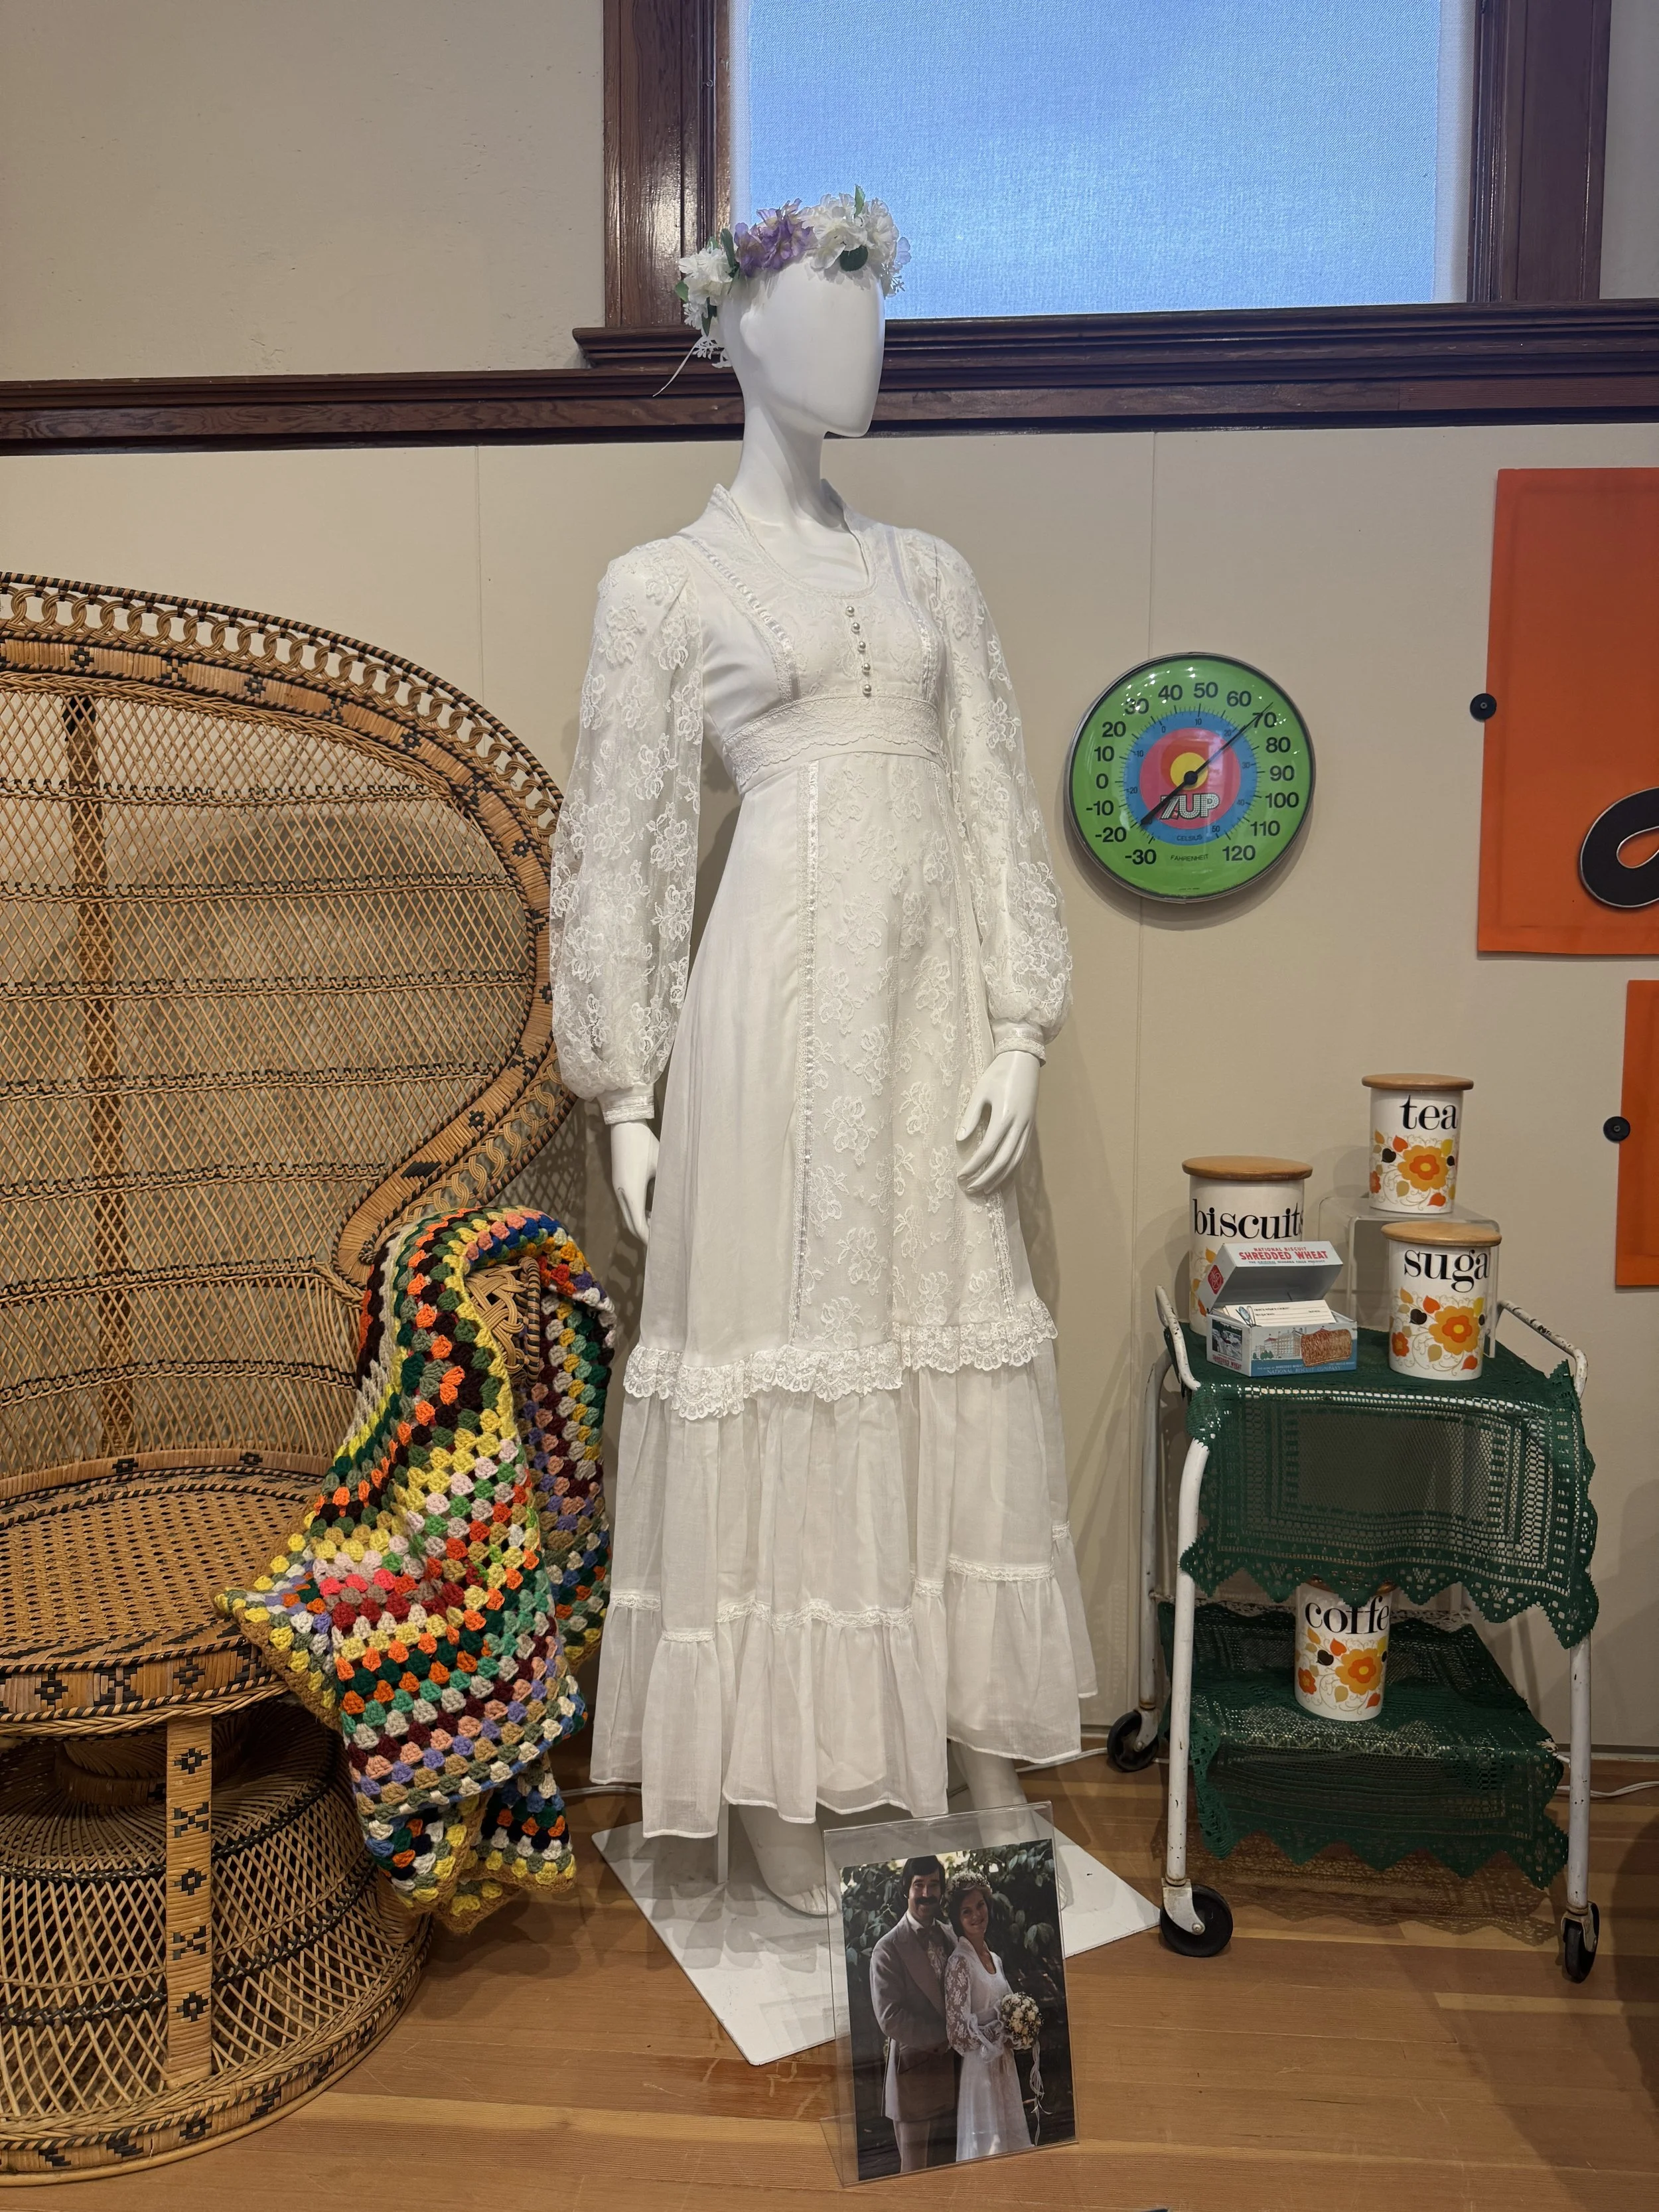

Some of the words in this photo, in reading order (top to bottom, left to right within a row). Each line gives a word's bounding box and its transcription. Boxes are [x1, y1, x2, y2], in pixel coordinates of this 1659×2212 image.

[1158, 684, 1183, 702] 40
[1194, 682, 1218, 698] 50
[1125, 698, 1149, 715] 30
[1227, 691, 1252, 707] 60
[1253, 712, 1277, 728] 70
[1102, 721, 1126, 737] 20
[1265, 737, 1291, 753] 80
[1094, 746, 1114, 762] 10
[1096, 773, 1109, 789] 0
[1269, 765, 1295, 781] 90
[1086, 800, 1114, 816] -10
[1265, 792, 1299, 808] 100
[1095, 827, 1127, 842] -20
[1250, 820, 1280, 836] 110
[1125, 849, 1157, 865] -30
[1222, 845, 1256, 861] 120
[1399, 1094, 1457, 1130] tea
[1239, 1251, 1292, 1260] SHREDDED
[1295, 1250, 1329, 1260] WHEAT
